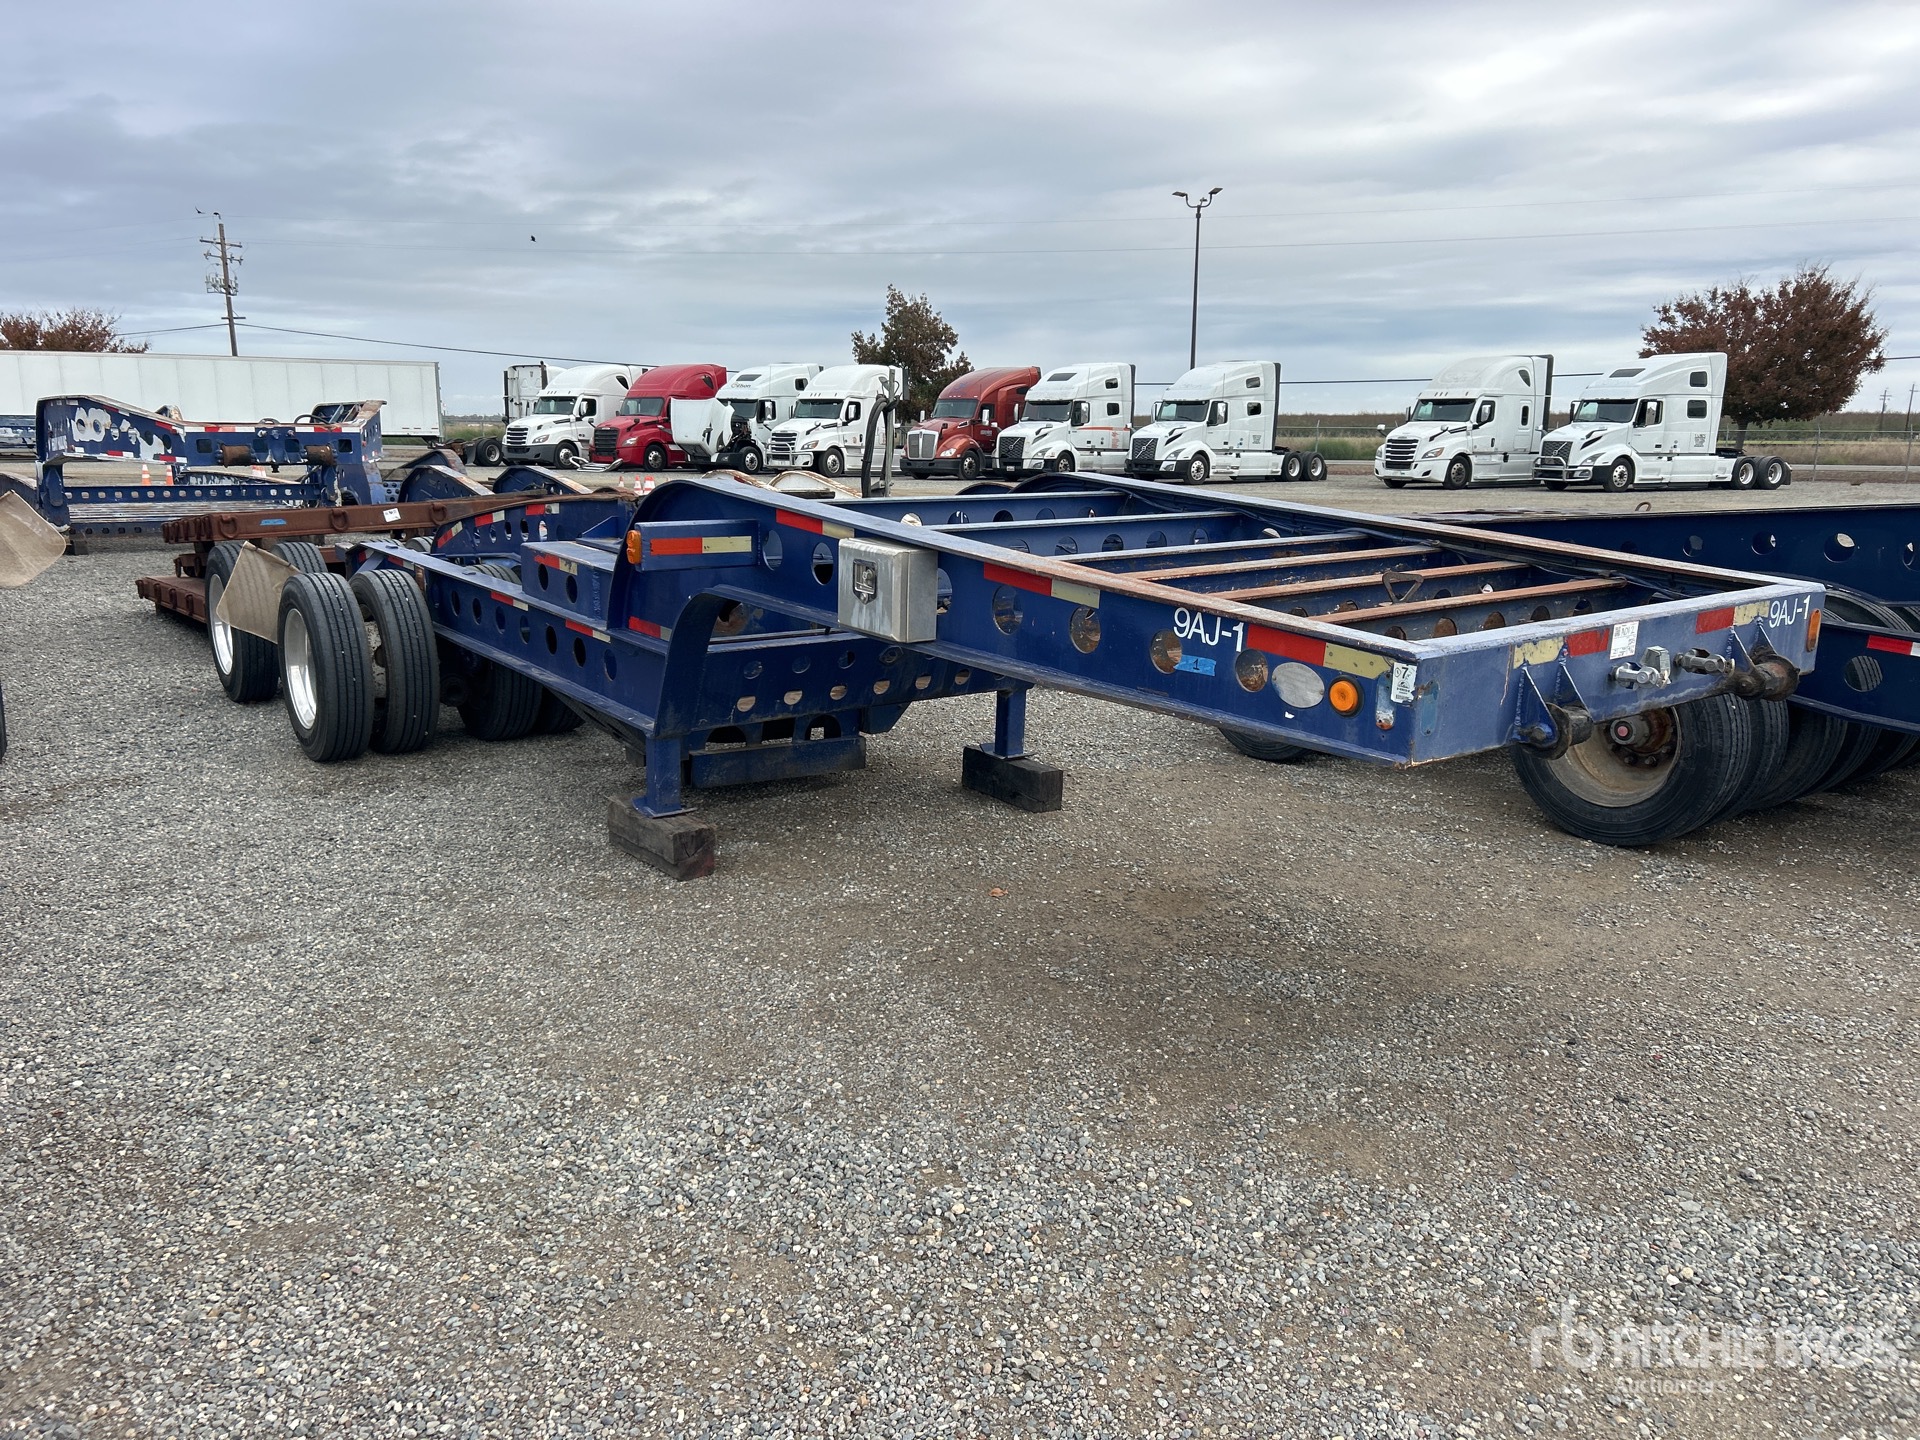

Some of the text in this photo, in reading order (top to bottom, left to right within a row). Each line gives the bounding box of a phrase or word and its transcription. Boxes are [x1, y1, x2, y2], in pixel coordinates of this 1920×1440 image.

[1769, 595, 1811, 629] 9AJ-1
[1173, 607, 1244, 652] 9AJ-1
[1193, 658, 1200, 671] 1
[1401, 666, 1409, 679] 7
